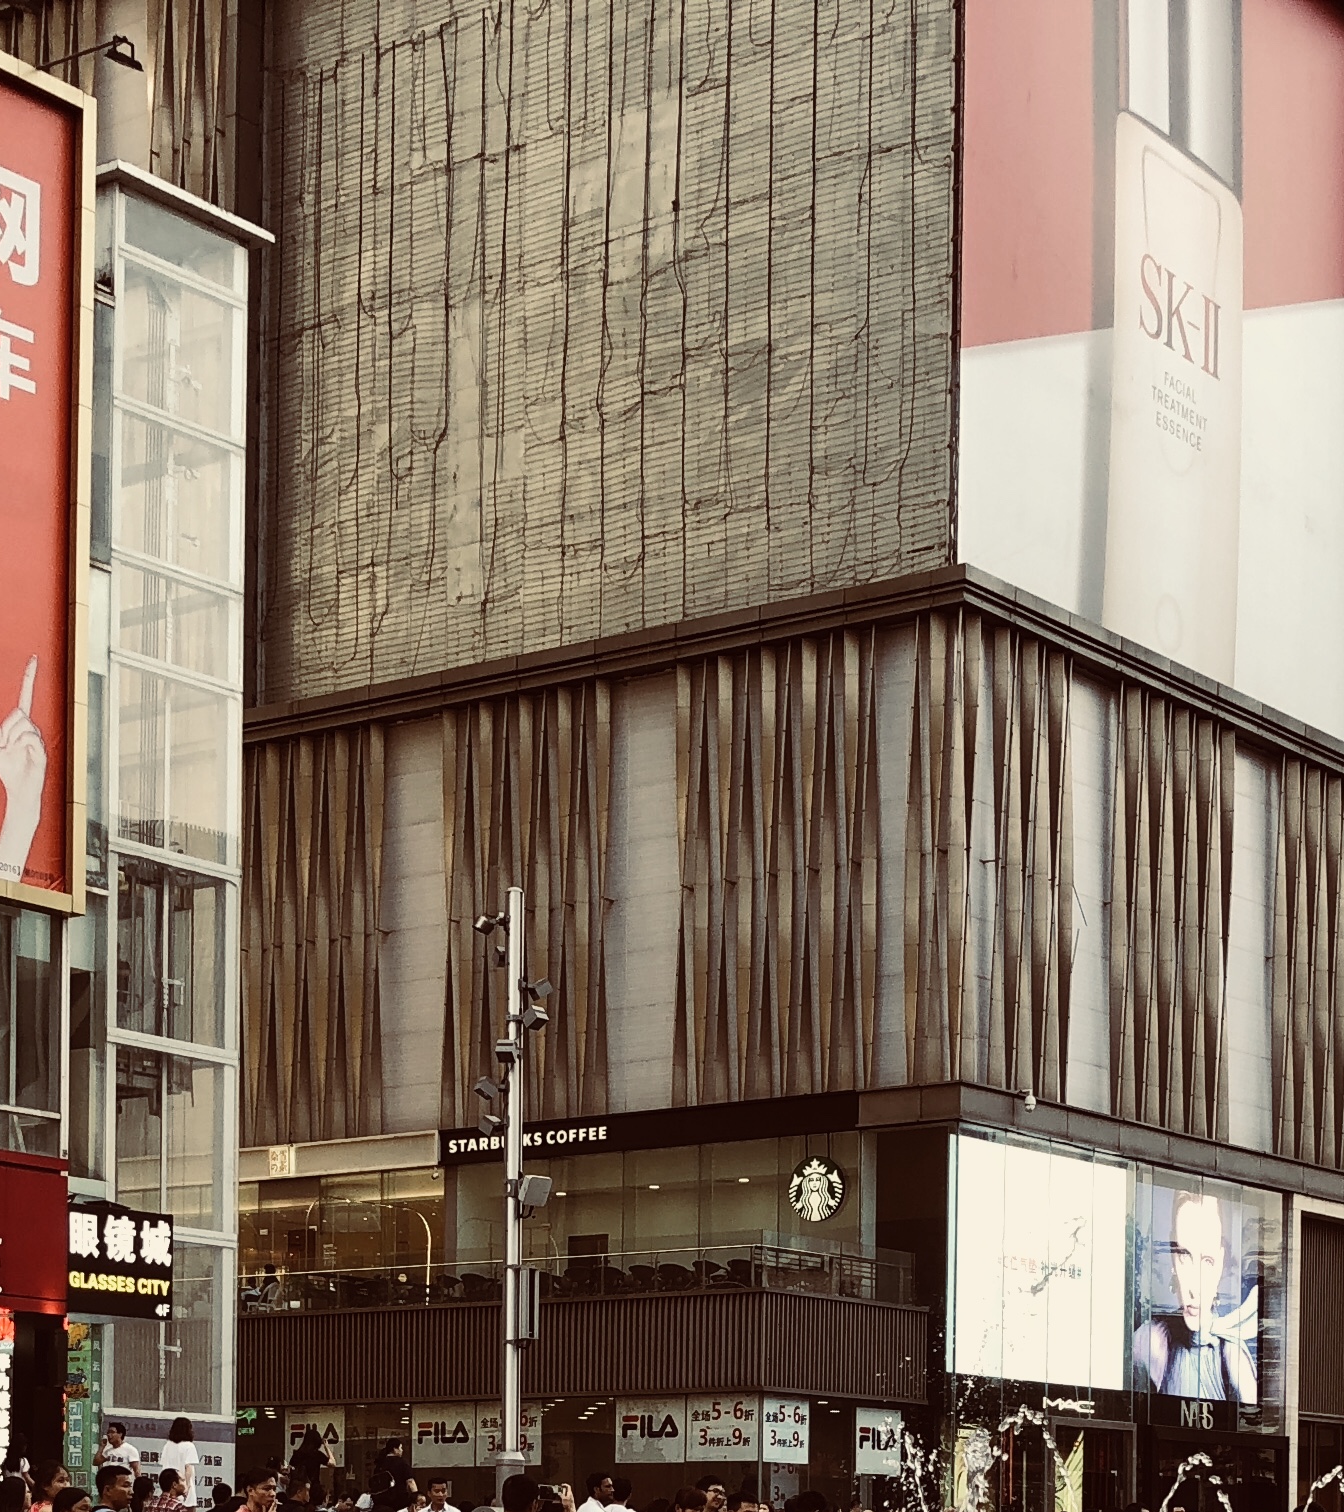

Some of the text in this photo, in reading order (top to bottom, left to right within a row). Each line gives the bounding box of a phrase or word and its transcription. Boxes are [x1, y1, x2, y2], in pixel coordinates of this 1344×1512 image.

[1139, 254, 1221, 381] SK-II
[1164, 371, 1196, 405] FACIAL
[1151, 385, 1208, 432] TREATMENT
[1156, 411, 1202, 452] ESSENCE
[448, 1126, 608, 1153] STARBKS COFFEE
[69, 1211, 172, 1267] 眼镜城
[69, 1271, 170, 1296] GLASSES CITY
[155, 1304, 170, 1317] 4F
[691, 1401, 755, 1422] 全场5-6折
[765, 1405, 807, 1426] 全场5-6折
[1043, 1397, 1095, 1414] MAC
[1181, 1400, 1214, 1430] NARS
[417, 1421, 470, 1445] FILA
[621, 1414, 679, 1438] FILA
[698, 1428, 751, 1447] 3件折上9折
[770, 1429, 805, 1449] 3件折上9折
